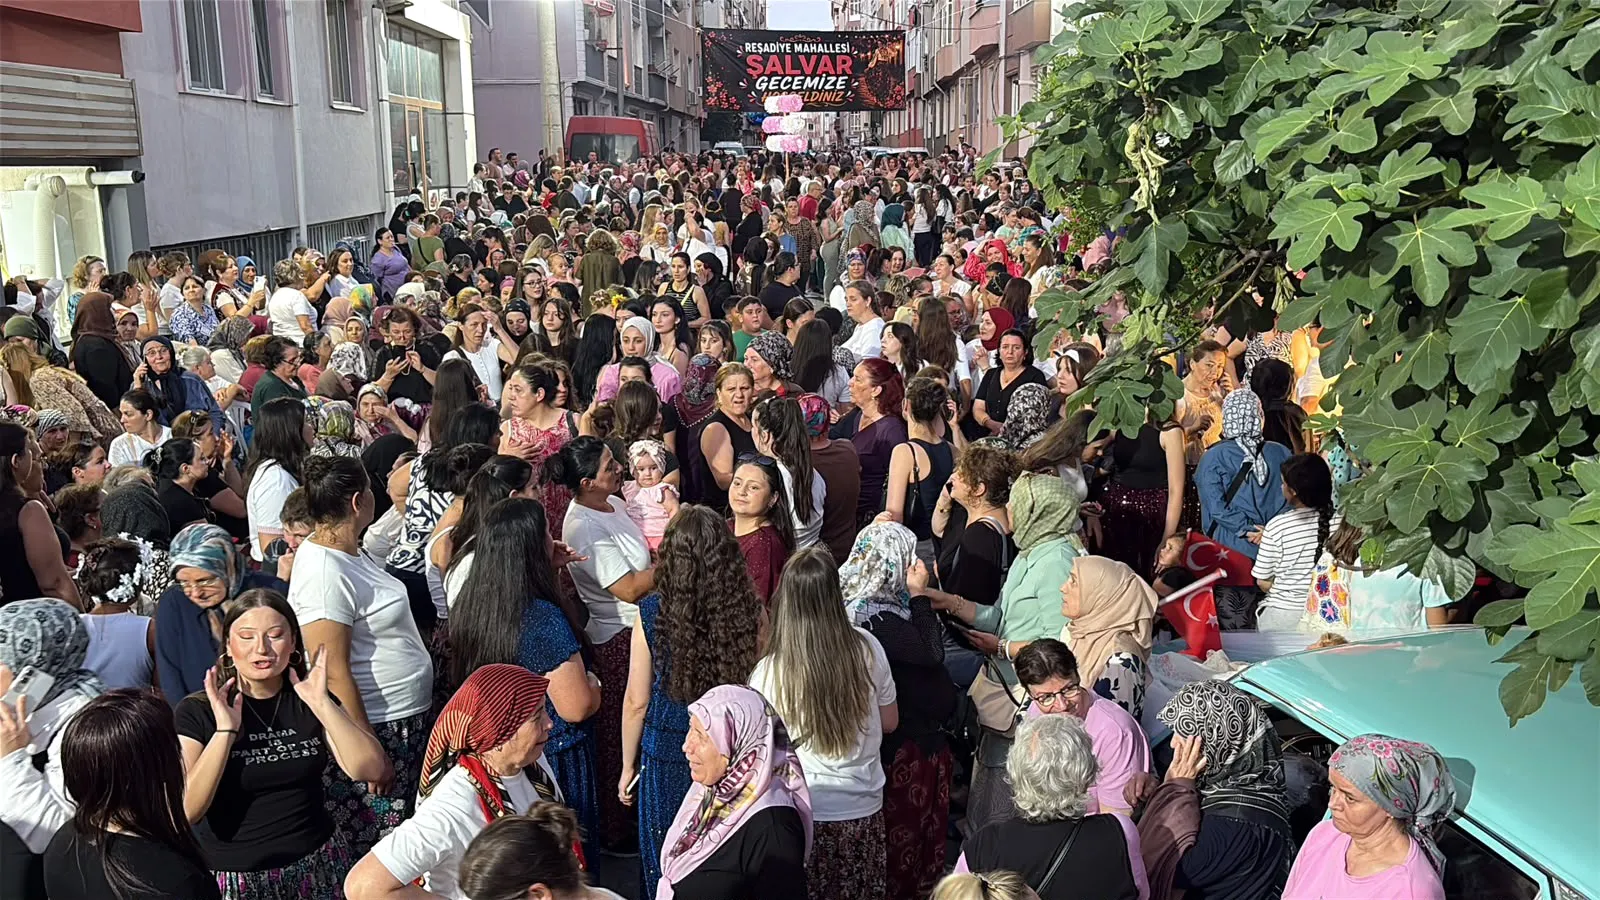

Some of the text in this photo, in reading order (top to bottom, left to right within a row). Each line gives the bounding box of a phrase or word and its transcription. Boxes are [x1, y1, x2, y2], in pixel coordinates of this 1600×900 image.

[745, 42, 850, 54] REŞADİYE MAHALLESİ
[746, 54, 853, 79] ŞALVAR
[755, 74, 849, 91] GECEMİZE
[249, 728, 296, 741] DRAMA
[232, 747, 270, 759] PART
[245, 747, 318, 765] PROCESS
